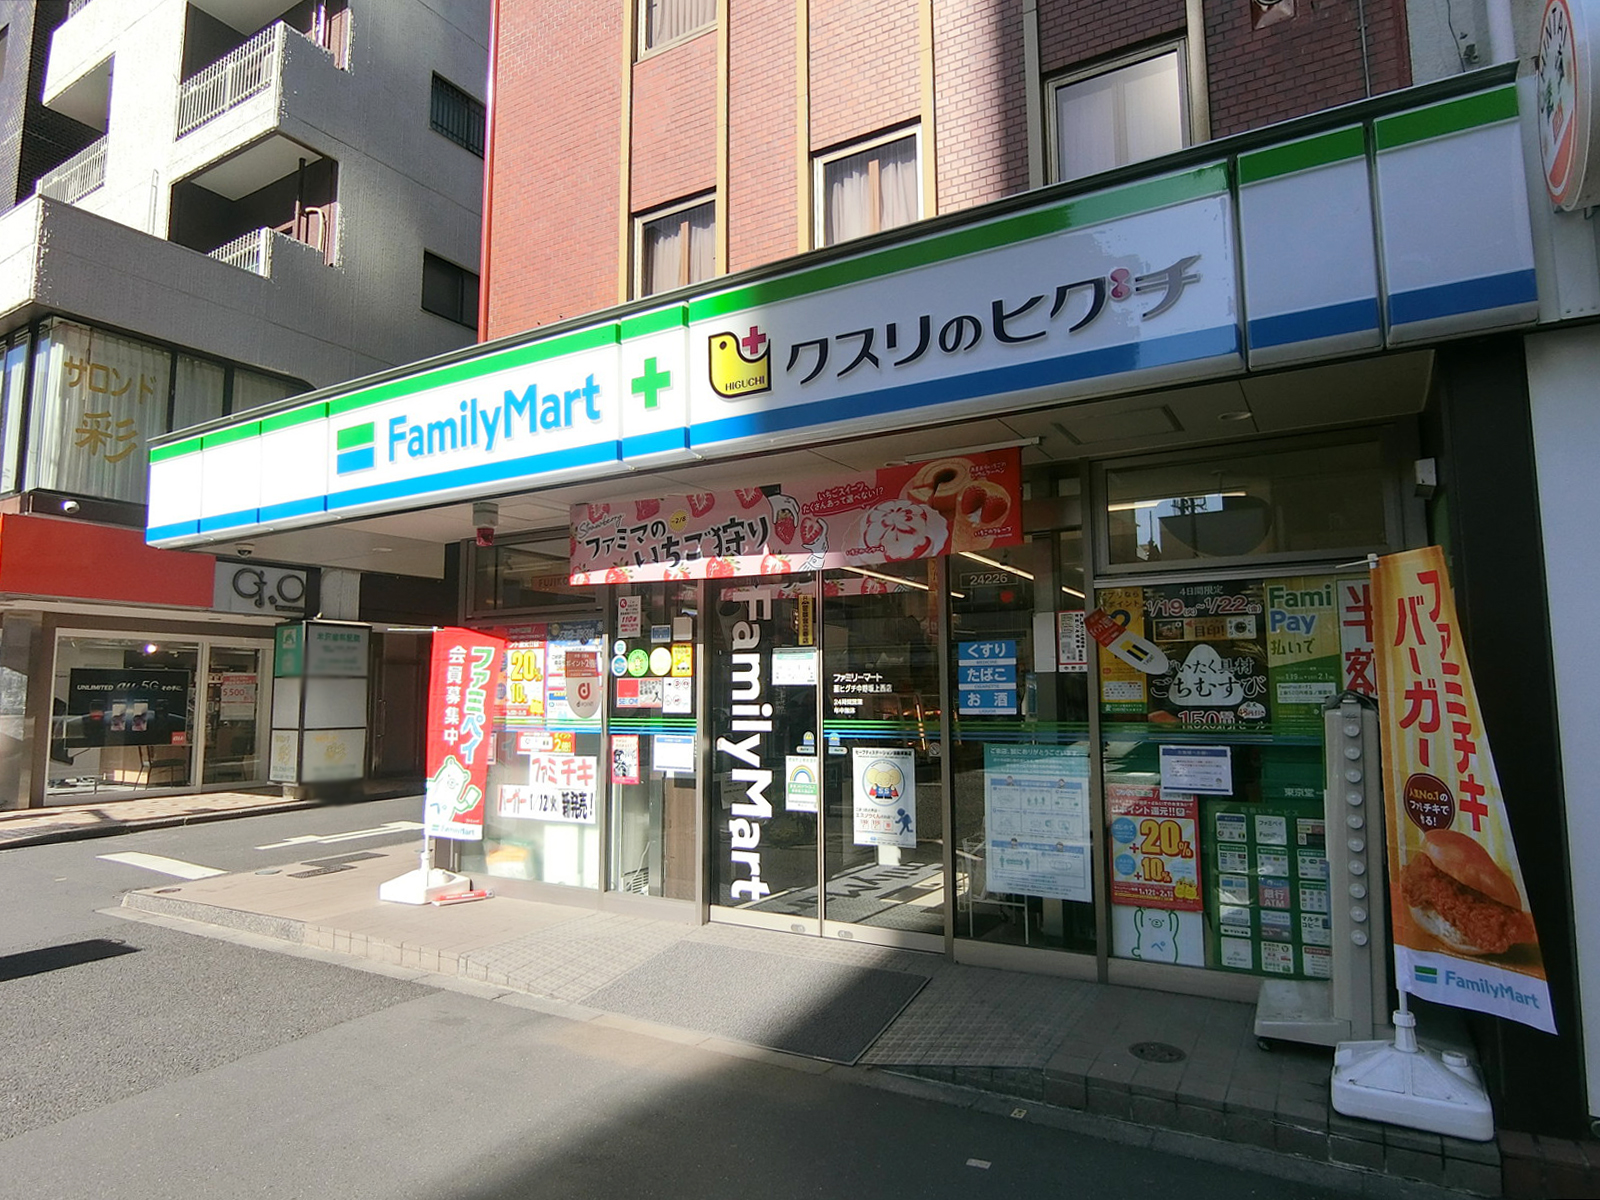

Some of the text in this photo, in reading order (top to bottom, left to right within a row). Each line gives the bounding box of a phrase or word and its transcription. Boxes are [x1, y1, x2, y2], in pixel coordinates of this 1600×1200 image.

[786, 254, 1202, 386] クスリのヒグチ
[64, 355, 157, 405] サロンド
[725, 376, 766, 393] HIGUCHI
[388, 373, 601, 463] FamilyMart
[75, 410, 139, 464] 彩
[585, 521, 667, 560] ファミマの
[634, 516, 769, 568] いちご狩り
[970, 574, 1008, 586] 24226
[1179, 585, 1223, 596] 4日間限定
[1268, 583, 1333, 609] Fami
[1194, 625, 1224, 637] 目印!
[1270, 609, 1317, 635] Pay
[968, 643, 1006, 658] くすり
[1270, 638, 1316, 655] 払いで
[140, 680, 159, 691] 5G
[832, 672, 883, 683] ファミリーマート
[967, 667, 1007, 682] たばこ
[1150, 676, 1267, 699] ごちむすび
[1393, 595, 1441, 768] バーガー
[444, 645, 467, 746] 会員募集中
[461, 647, 495, 765] ファミペイ
[1416, 569, 1489, 832] ファミチキ
[716, 589, 773, 902] FamilyMart
[531, 757, 594, 787] ファミチキ
[1409, 800, 1450, 815] ファミチキで
[1264, 888, 1290, 899] 銀行
[1445, 970, 1540, 1009] FamilyMart
